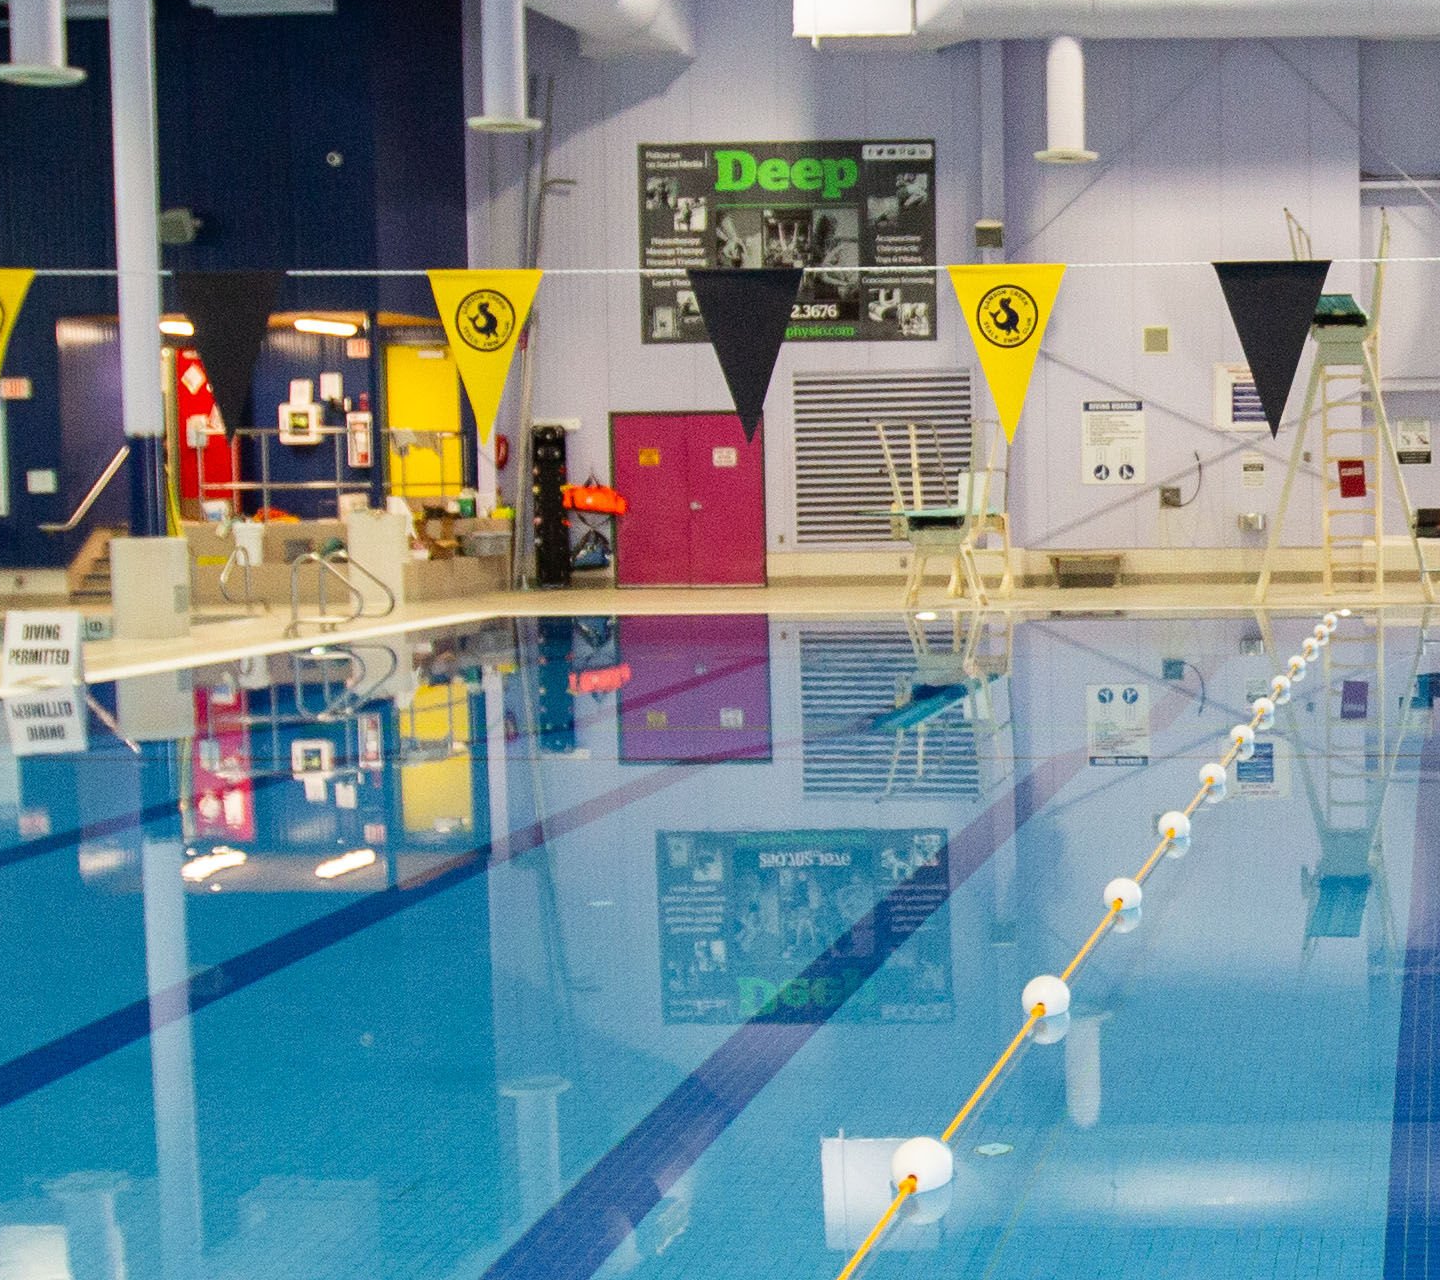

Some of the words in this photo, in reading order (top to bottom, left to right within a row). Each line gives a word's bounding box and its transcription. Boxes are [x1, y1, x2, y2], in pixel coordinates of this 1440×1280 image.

[714, 149, 859, 199] Deep
[790, 304, 838, 319] 2.3676
[785, 325, 854, 339] physio.com
[22, 624, 61, 640] DIVING
[8, 648, 70, 665] PERMITTED
